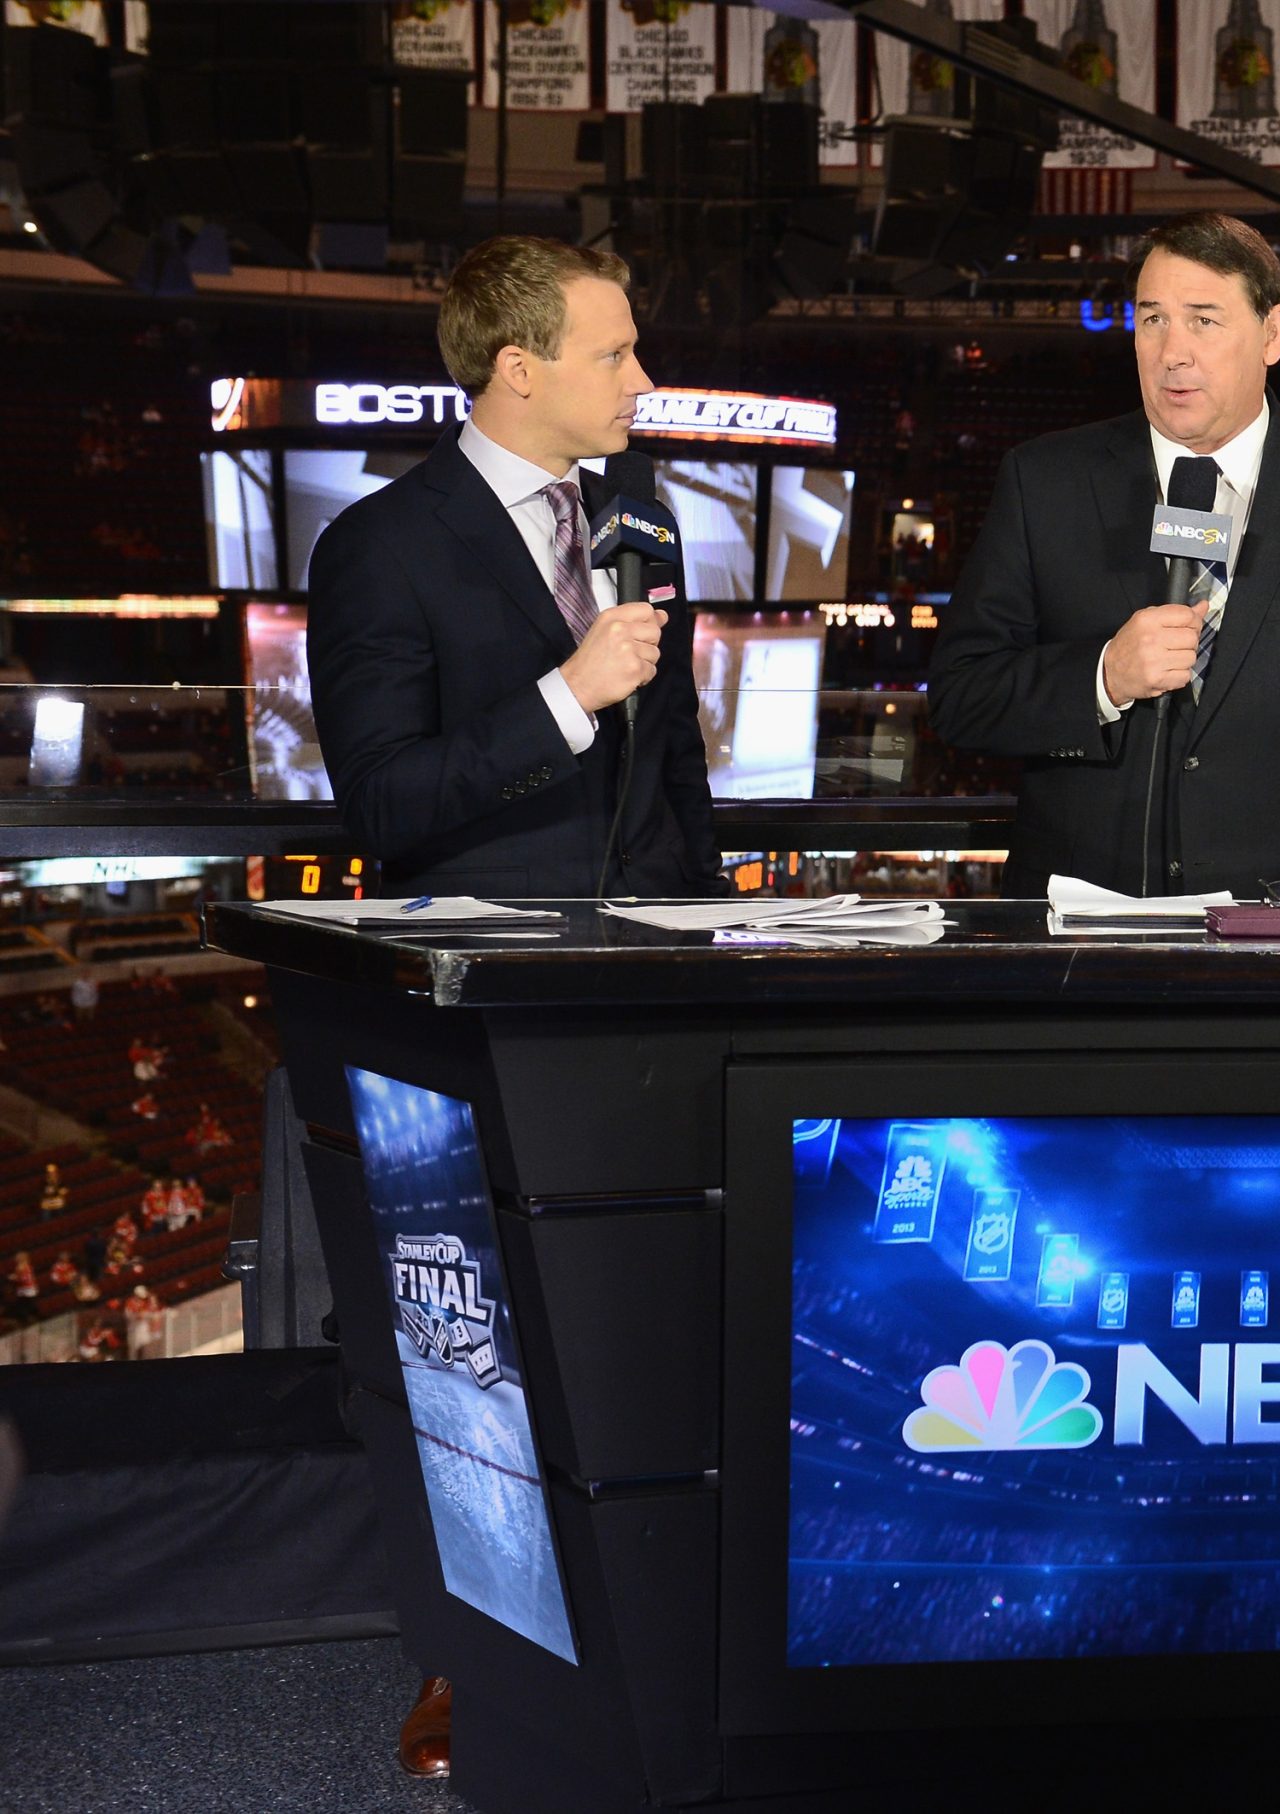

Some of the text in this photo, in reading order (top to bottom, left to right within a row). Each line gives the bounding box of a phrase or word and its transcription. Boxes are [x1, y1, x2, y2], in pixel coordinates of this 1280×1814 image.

[1190, 119, 1259, 134] STANLEY
[635, 517, 675, 544] NBCSN
[1174, 525, 1228, 545] NBCSN
[398, 1241, 461, 1265] STANLEY CUP
[394, 1262, 488, 1322] FINAL
